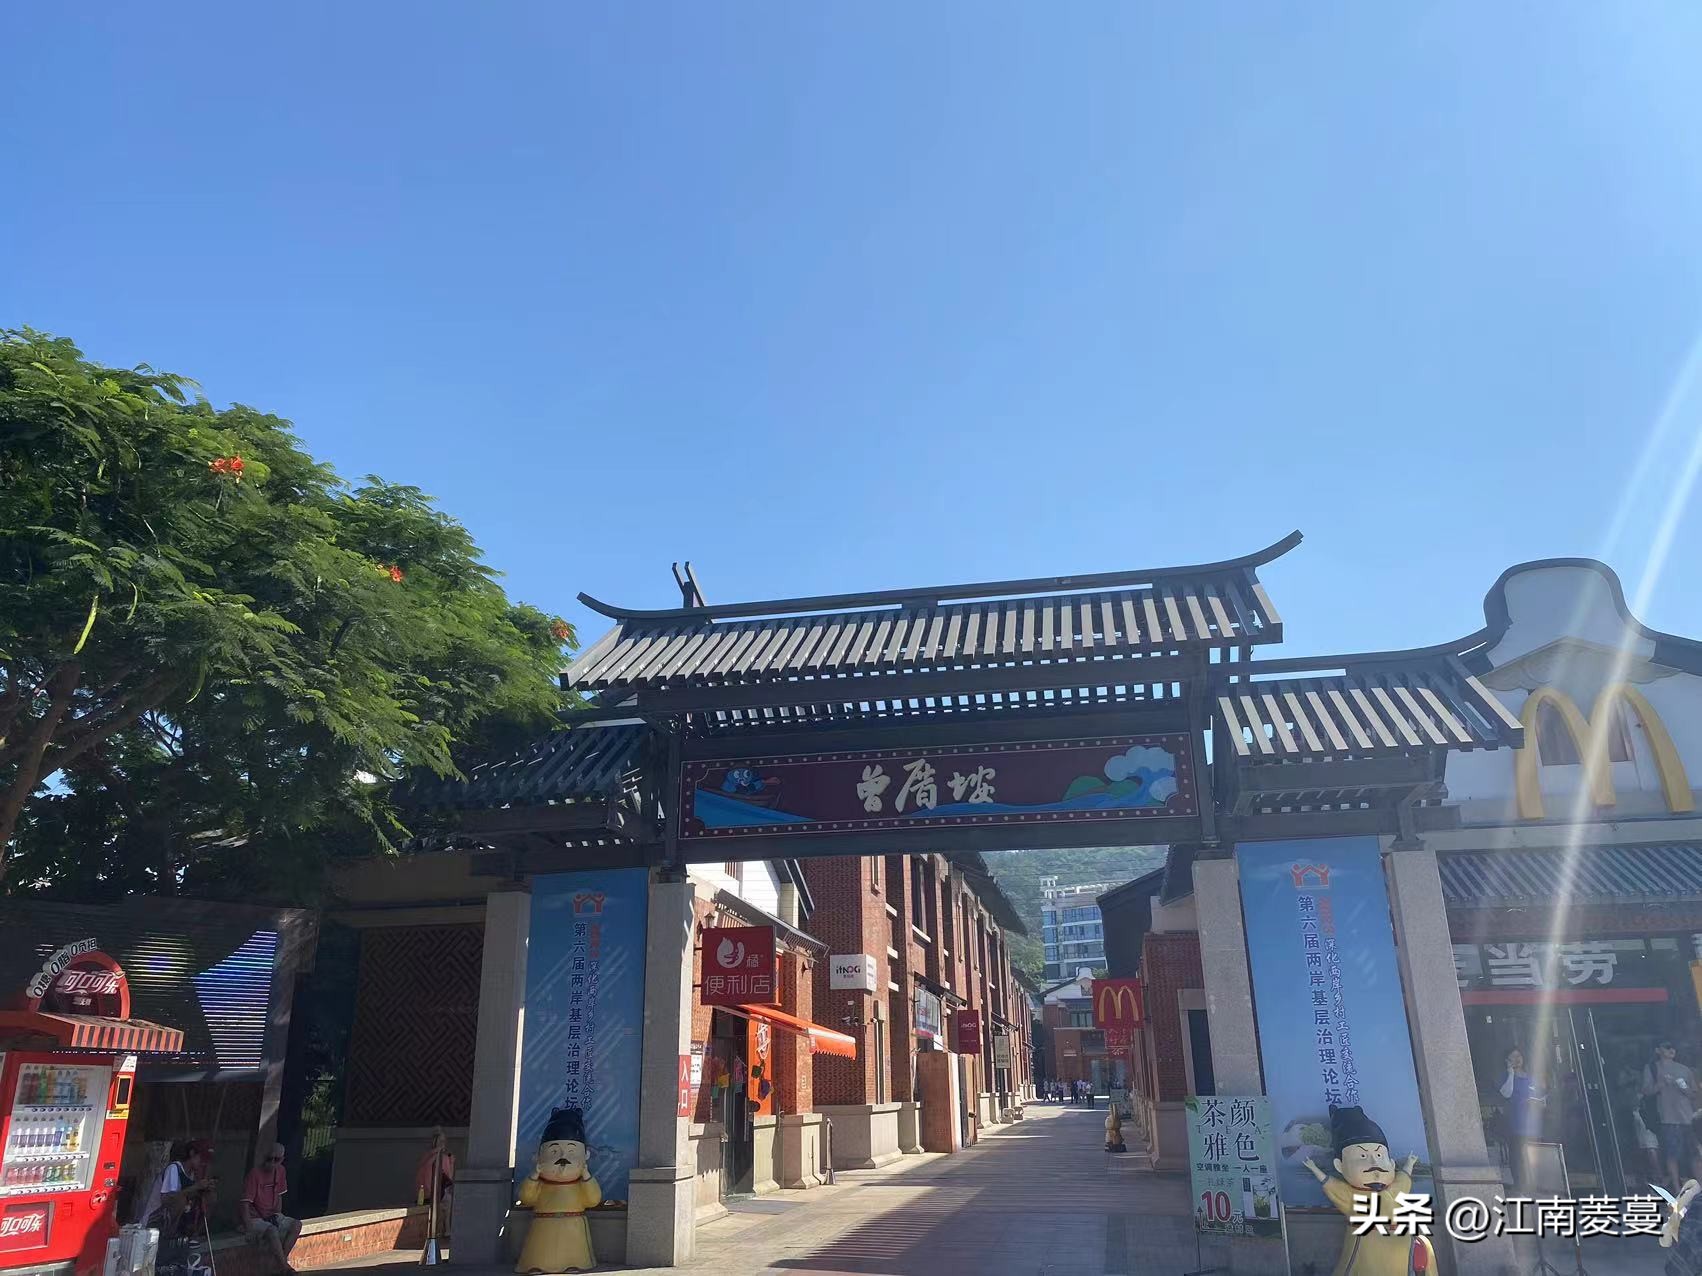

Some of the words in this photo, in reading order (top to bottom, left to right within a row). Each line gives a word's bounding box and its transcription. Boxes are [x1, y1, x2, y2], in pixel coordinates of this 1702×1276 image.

[857, 759, 996, 812] 曾厝垵
[62, 969, 125, 994] 可口可乐
[705, 974, 770, 995] 便利店
[1297, 896, 1342, 1104] 第六届两岸基层治理论坛
[564, 922, 588, 1110] 第六届两岸基层治理论坛
[681, 1059, 689, 1109] 入口
[1200, 1098, 1256, 1128] 茶颜
[1203, 1132, 1260, 1161] 雅色
